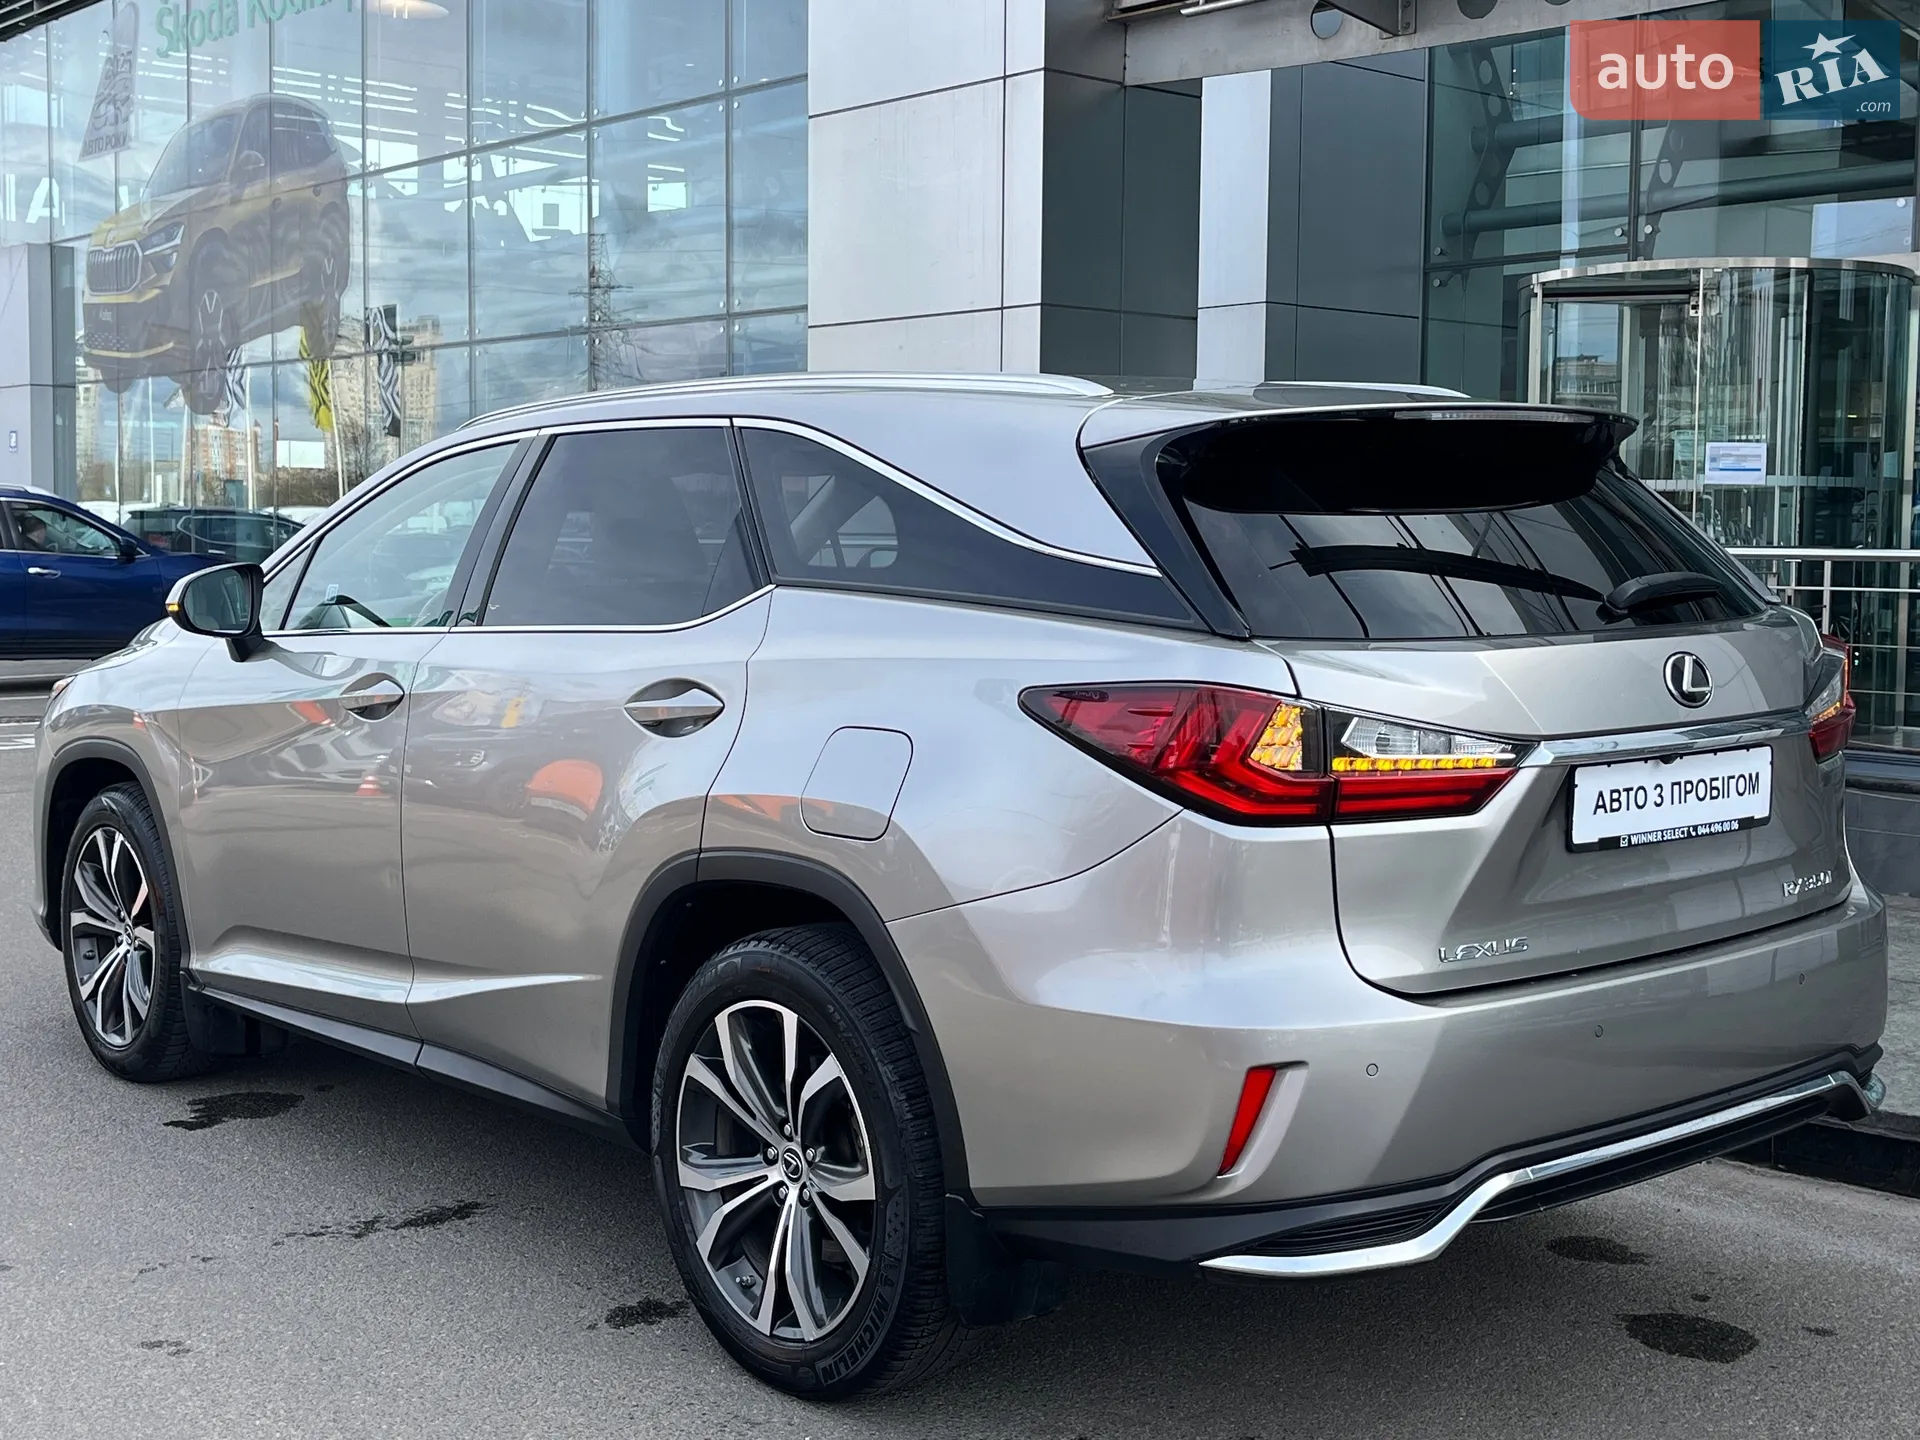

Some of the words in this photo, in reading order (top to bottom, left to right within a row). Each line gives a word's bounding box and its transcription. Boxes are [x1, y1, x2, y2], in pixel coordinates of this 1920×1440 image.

[1593, 785, 1647, 815] АВТО
[1671, 772, 1760, 805] ПРОБІГОМ
[1630, 831, 1662, 845] WINNER
[1663, 827, 1688, 840] SELECT
[1439, 936, 1528, 962] LEXUS
[820, 1291, 891, 1384] MICHELIN
